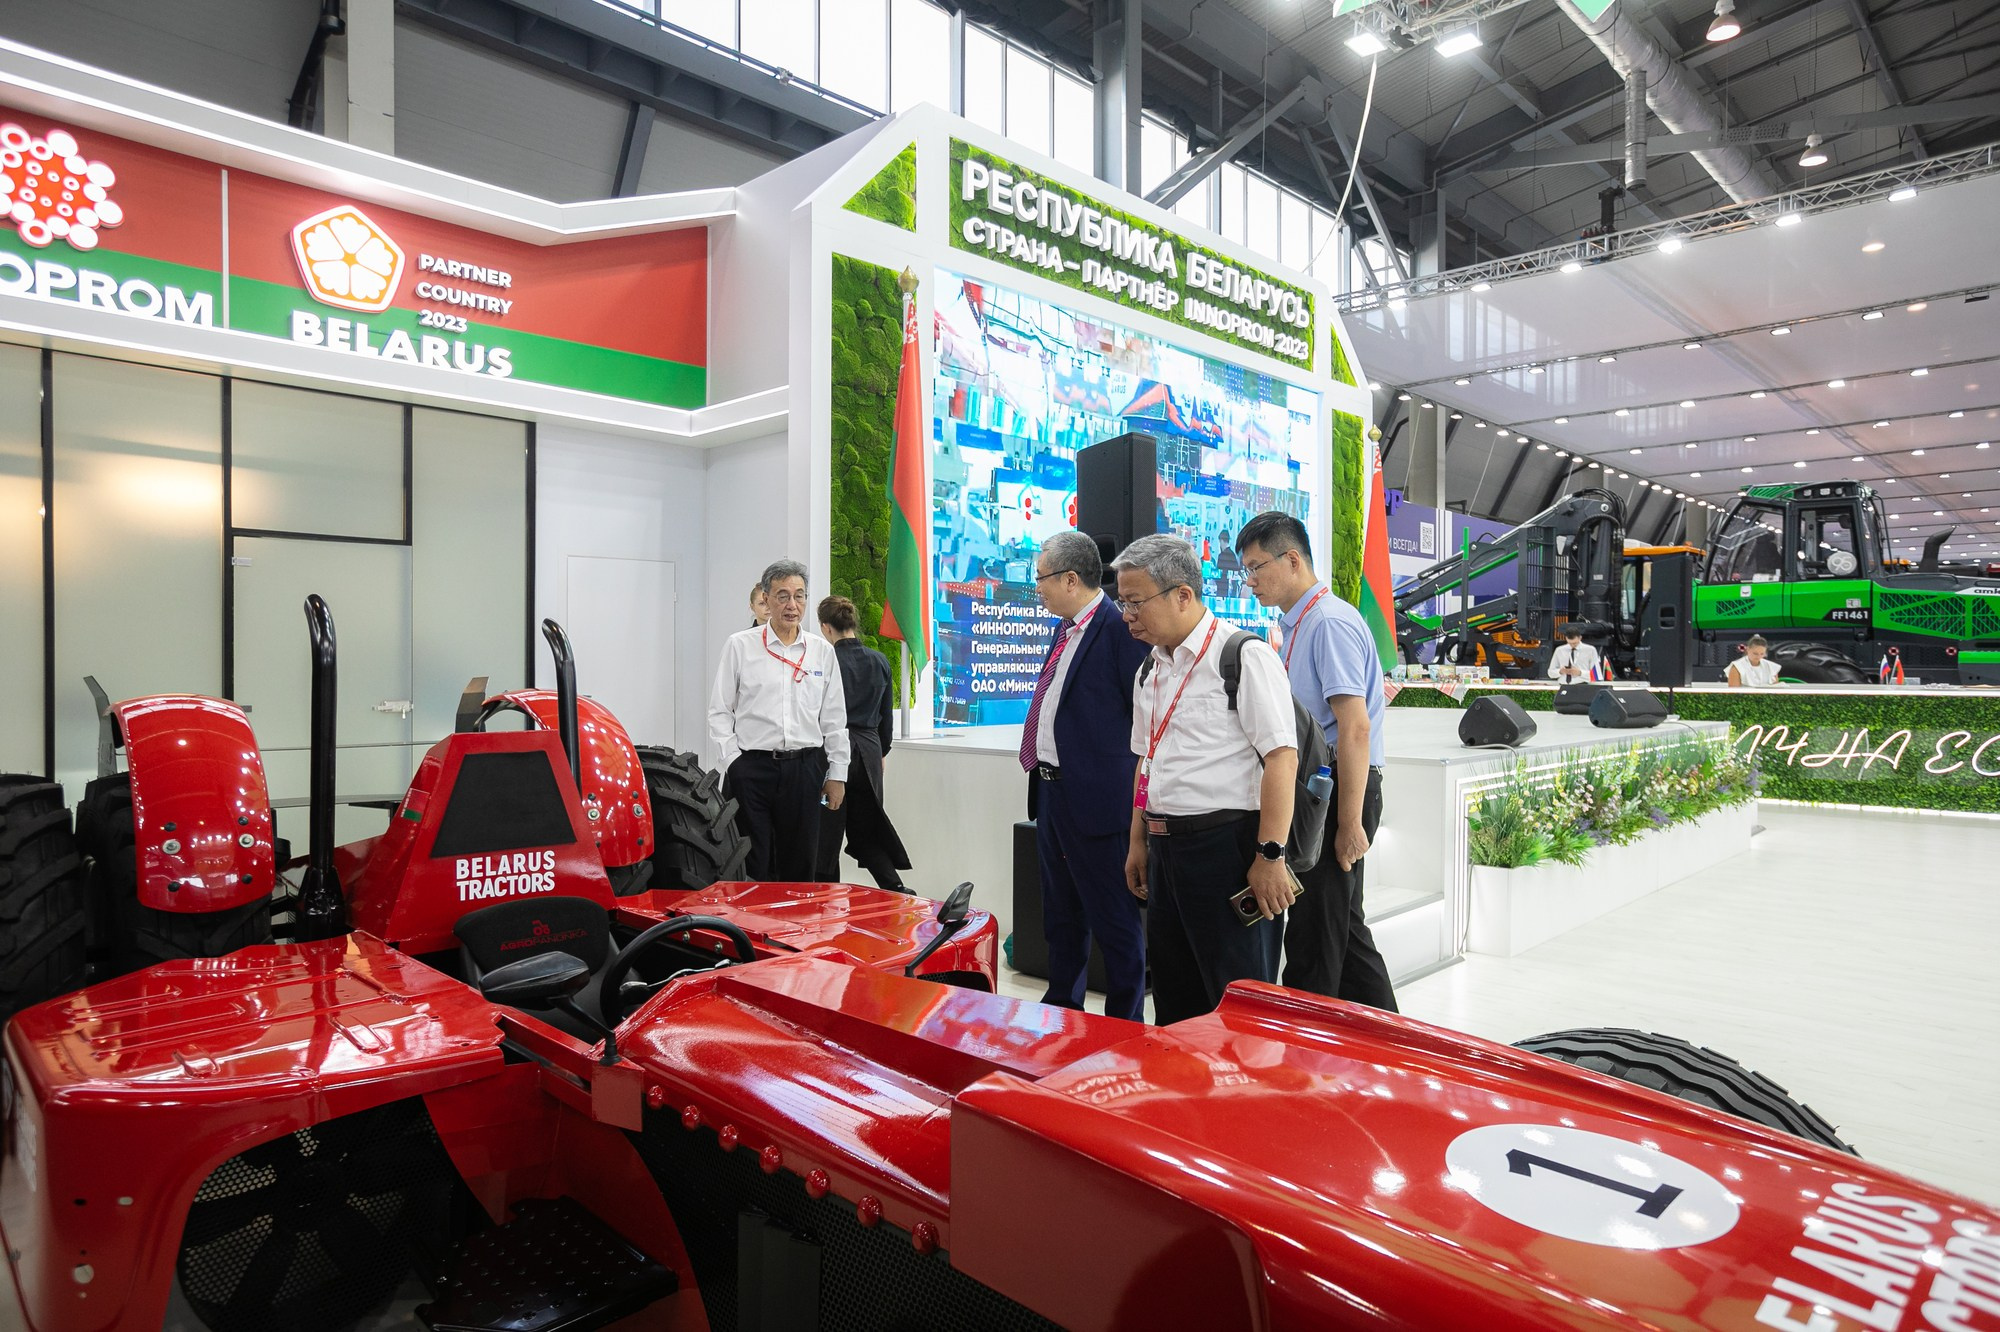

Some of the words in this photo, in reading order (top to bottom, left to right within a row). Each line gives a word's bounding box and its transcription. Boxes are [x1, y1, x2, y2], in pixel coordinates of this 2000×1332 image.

[962, 159, 1178, 279] РЕСПУБЛИКА
[1186, 252, 1310, 328] БЕЛАРУСЬ
[419, 254, 512, 288] PARTNER
[0, 252, 213, 327] OPROM
[416, 282, 513, 314] COUNTRY
[419, 309, 468, 333] 2023
[1184, 298, 1274, 348] INNOPROM
[1274, 333, 1309, 360] 2023
[291, 310, 513, 377] BELARUS
[971, 601, 1035, 620] Республика
[1832, 610, 1869, 620] FF1461
[971, 621, 1050, 637] «ИННОПРОМ»
[971, 641, 1041, 658] Генеральные
[971, 662, 1043, 677] управляюща
[971, 679, 996, 692] ОАО
[456, 850, 555, 880] BELARUS
[456, 871, 555, 901] TRACTORS
[1505, 1148, 1684, 1220] 1
